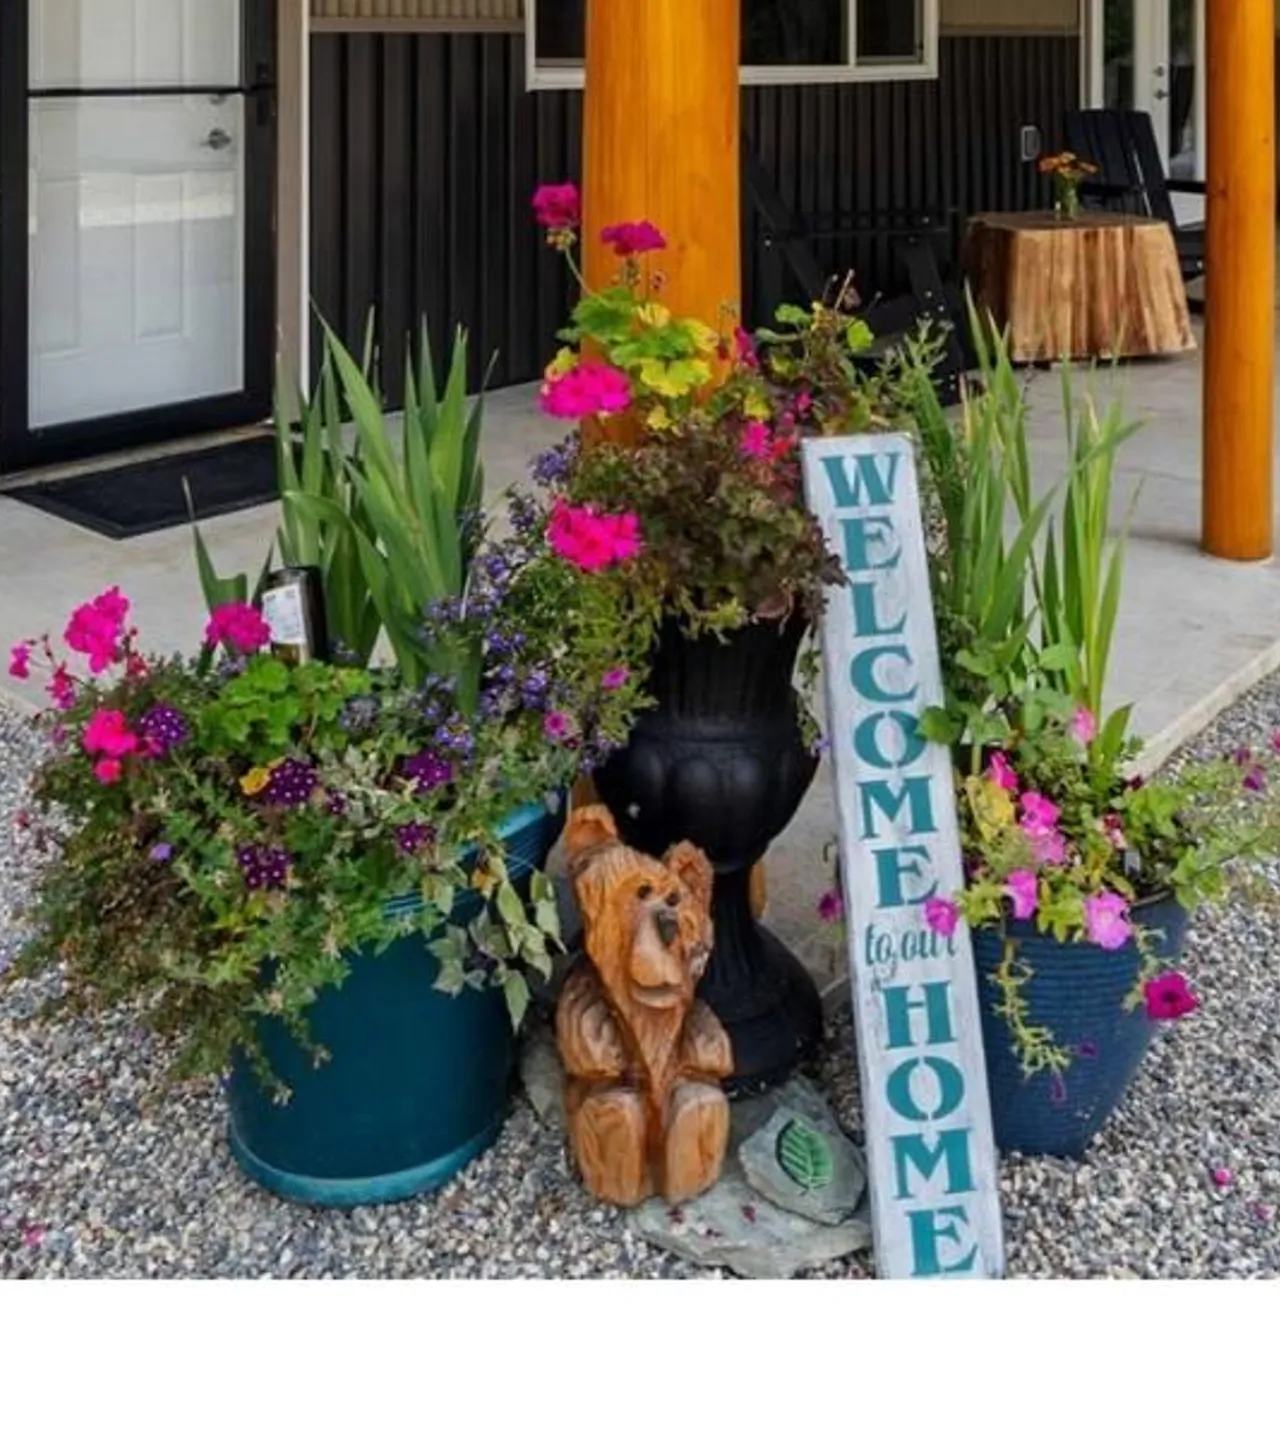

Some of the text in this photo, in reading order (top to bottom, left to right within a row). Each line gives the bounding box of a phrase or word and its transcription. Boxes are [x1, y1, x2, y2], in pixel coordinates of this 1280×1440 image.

[821, 452, 940, 909] WELCOME
[865, 922, 897, 968] to
[881, 980, 980, 1278] HOME
